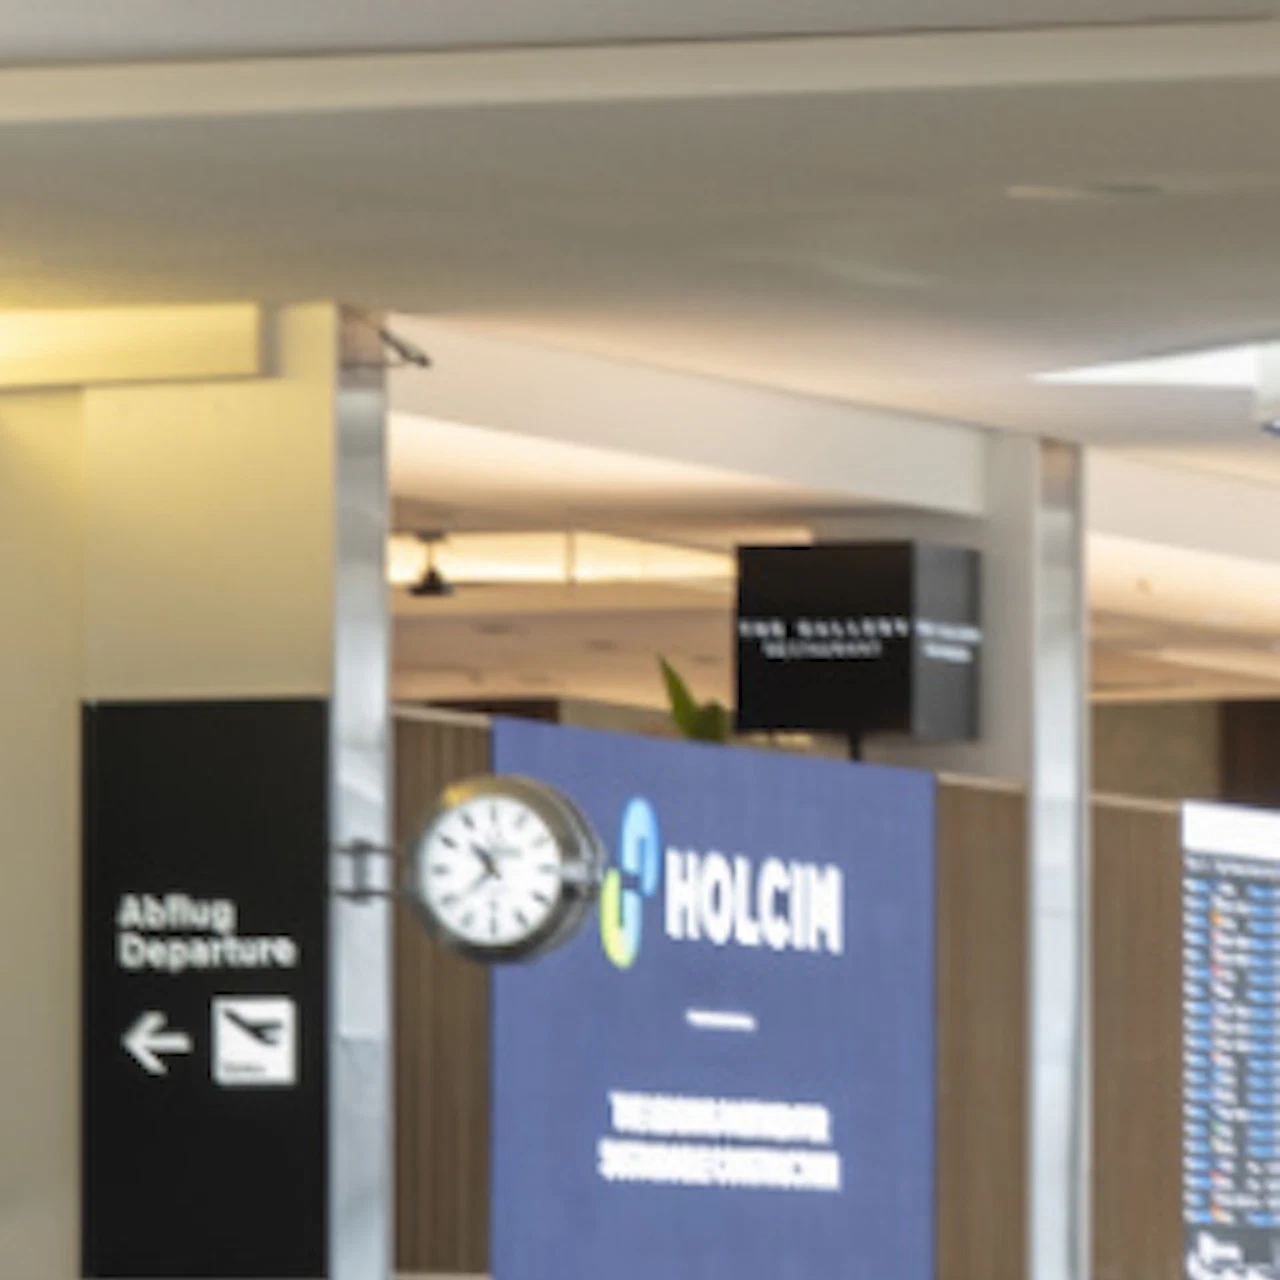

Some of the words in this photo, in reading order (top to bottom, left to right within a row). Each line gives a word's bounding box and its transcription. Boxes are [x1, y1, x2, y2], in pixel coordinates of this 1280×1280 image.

[118, 892, 237, 936] Abflug
[665, 846, 844, 955] HOLCIM
[119, 931, 297, 975] Departure
